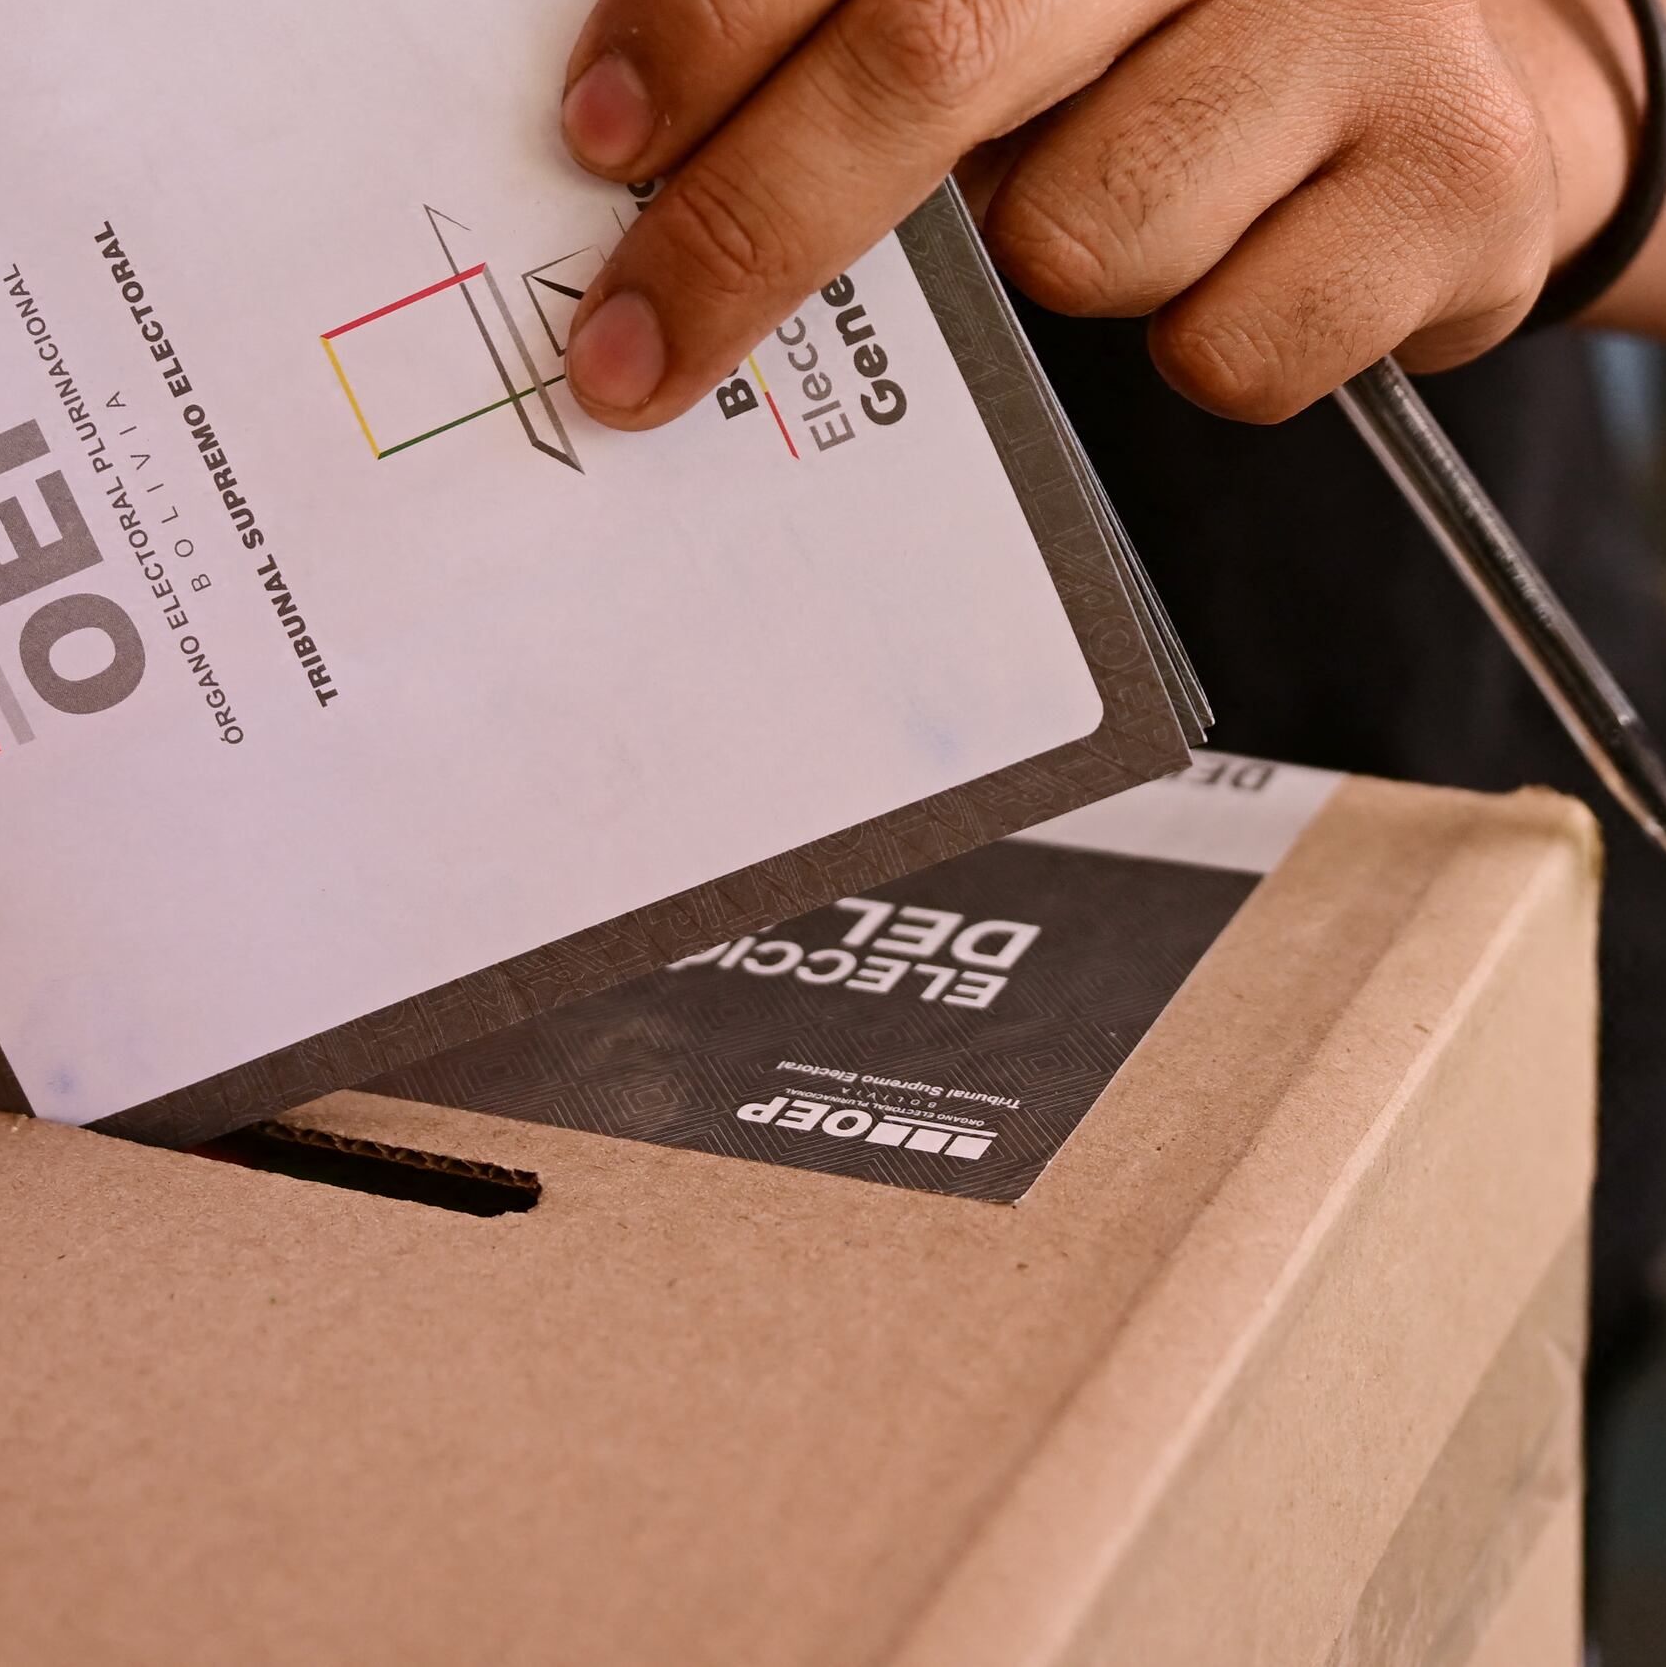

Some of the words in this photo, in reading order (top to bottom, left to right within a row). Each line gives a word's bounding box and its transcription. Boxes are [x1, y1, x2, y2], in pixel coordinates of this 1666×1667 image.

[3, 263, 113, 473] PLURINACIONAL
[95, 221, 192, 397] ELECTORAL
[820, 274, 908, 426] Gene
[776, 316, 856, 452] Elecc
[106, 391, 211, 592] BOLIVIA
[183, 404, 264, 549] SUPREMO
[106, 476, 188, 630] ELECTORAL
[180, 635, 244, 744] ÓRGANO
[257, 554, 338, 707] TRIBUNAL
[836, 898, 1041, 971] DEL
[736, 1096, 873, 1137] OEP
[776, 1060, 859, 1083] Electoral
[785, 1087, 870, 1108] PLURINACIONAL
[862, 1074, 944, 1097] Supremo
[872, 1101, 935, 1119] ELECTORAL
[947, 1088, 1022, 1110] Tribunal
